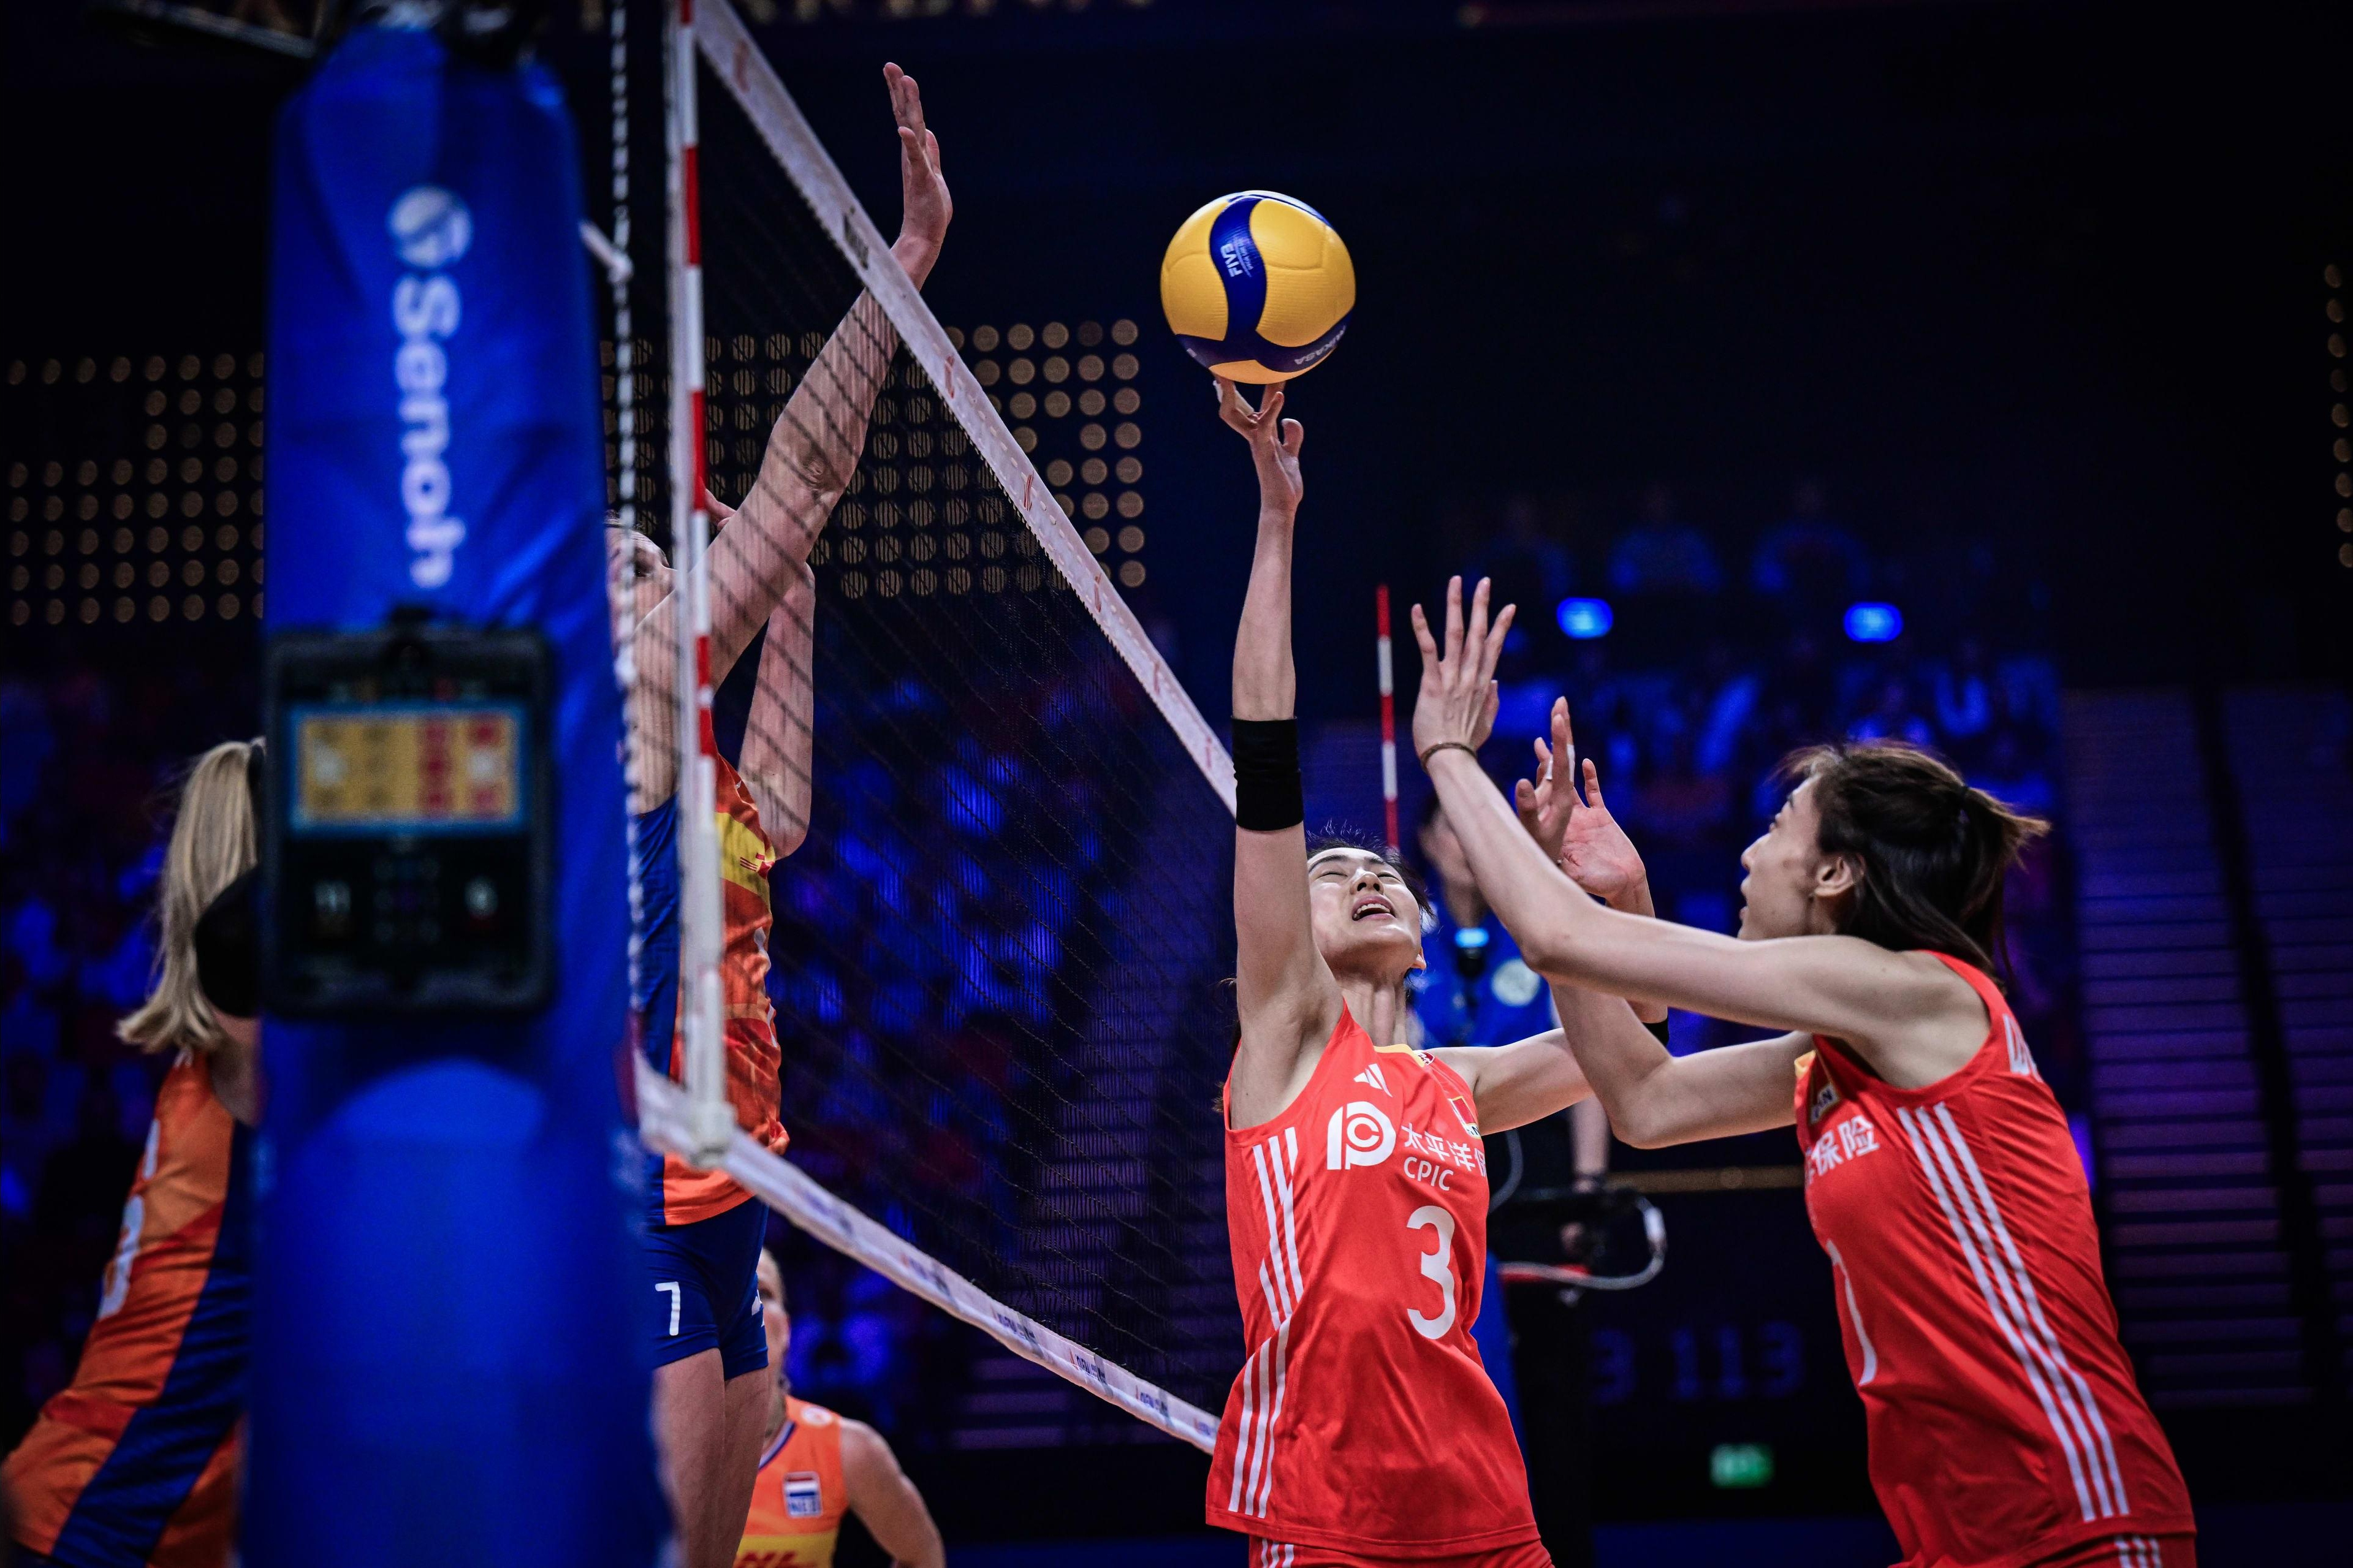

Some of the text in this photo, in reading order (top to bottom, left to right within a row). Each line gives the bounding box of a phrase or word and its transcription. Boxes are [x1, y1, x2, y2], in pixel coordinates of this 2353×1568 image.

[1220, 243, 1243, 277] FIVB
[1404, 1156, 1454, 1191] CPIC
[1406, 1205, 1456, 1339] 3
[655, 1281, 680, 1336] 7
